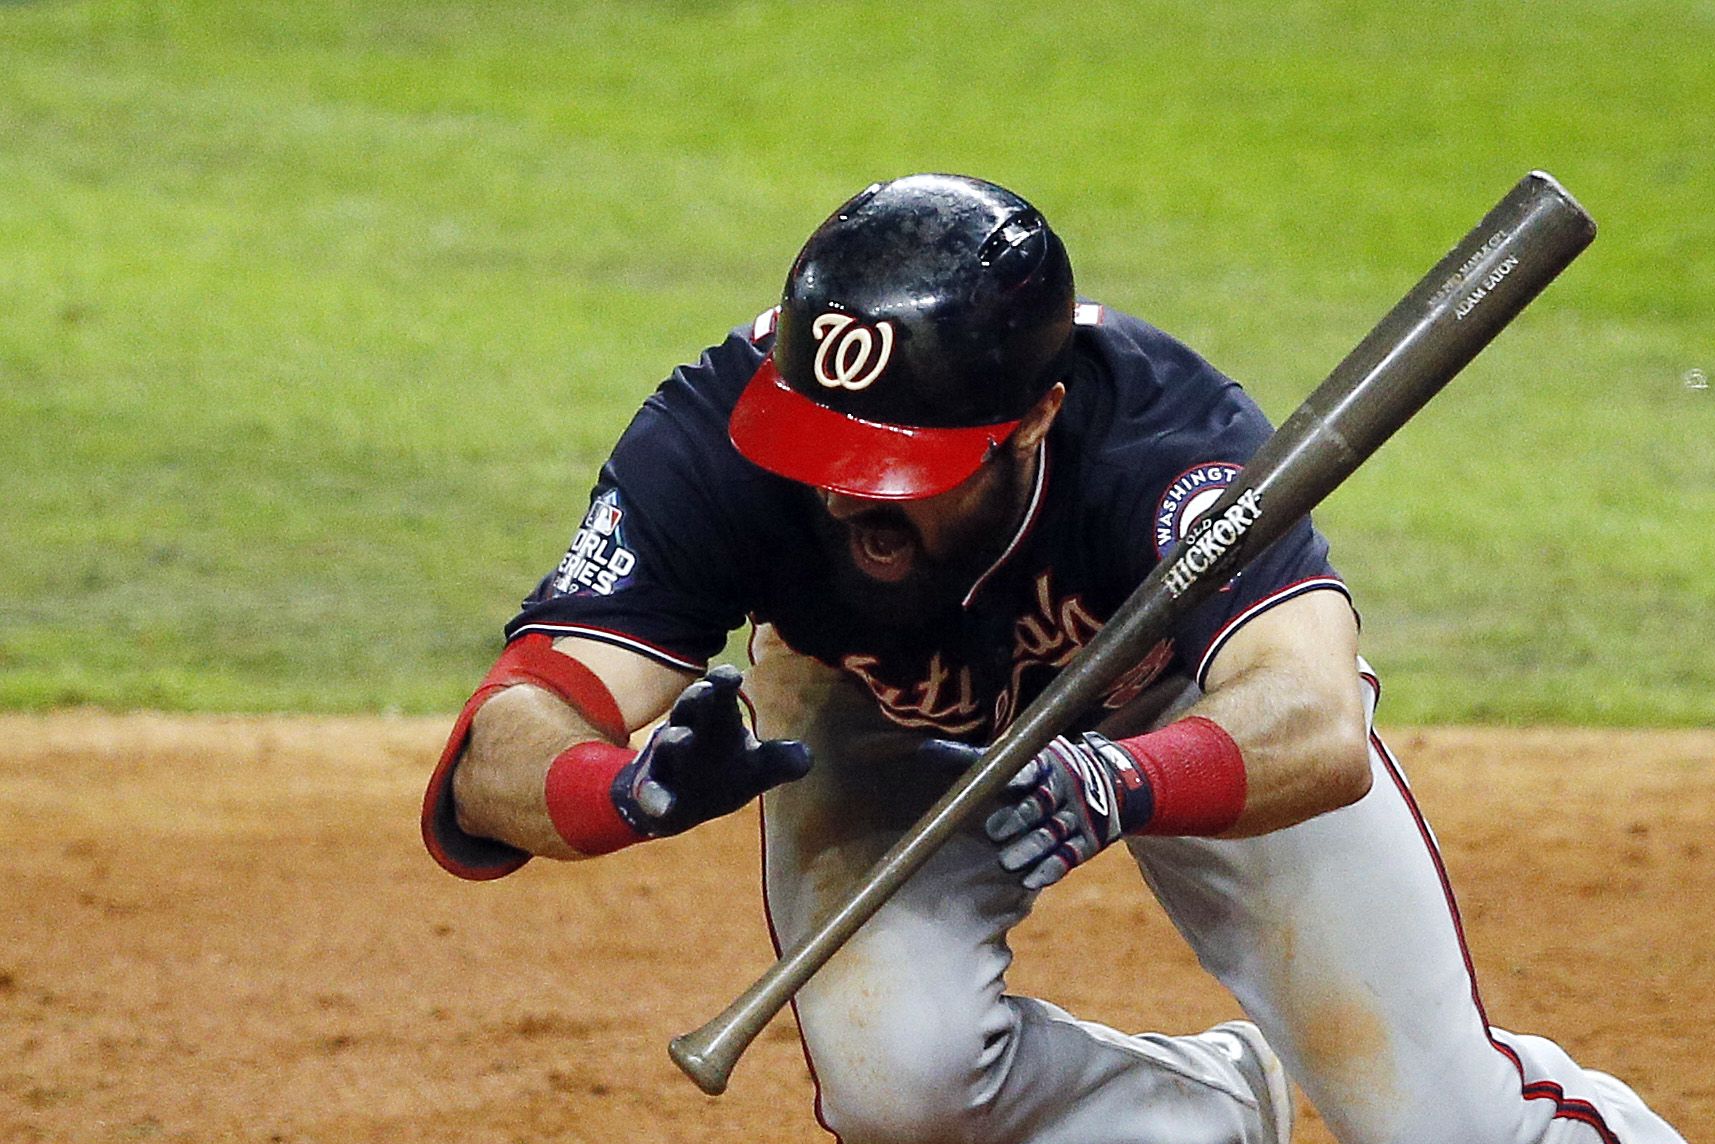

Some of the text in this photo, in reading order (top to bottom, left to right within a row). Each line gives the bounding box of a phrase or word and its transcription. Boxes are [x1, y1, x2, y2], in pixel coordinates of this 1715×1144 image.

[1455, 287, 1487, 320] ADAM
[1482, 255, 1519, 290] EATON
[811, 312, 894, 391] W
[571, 528, 636, 577] ORLD
[1161, 488, 1263, 599] HICKORY
[1185, 518, 1212, 545] OLD
[558, 552, 618, 596] ERIES
